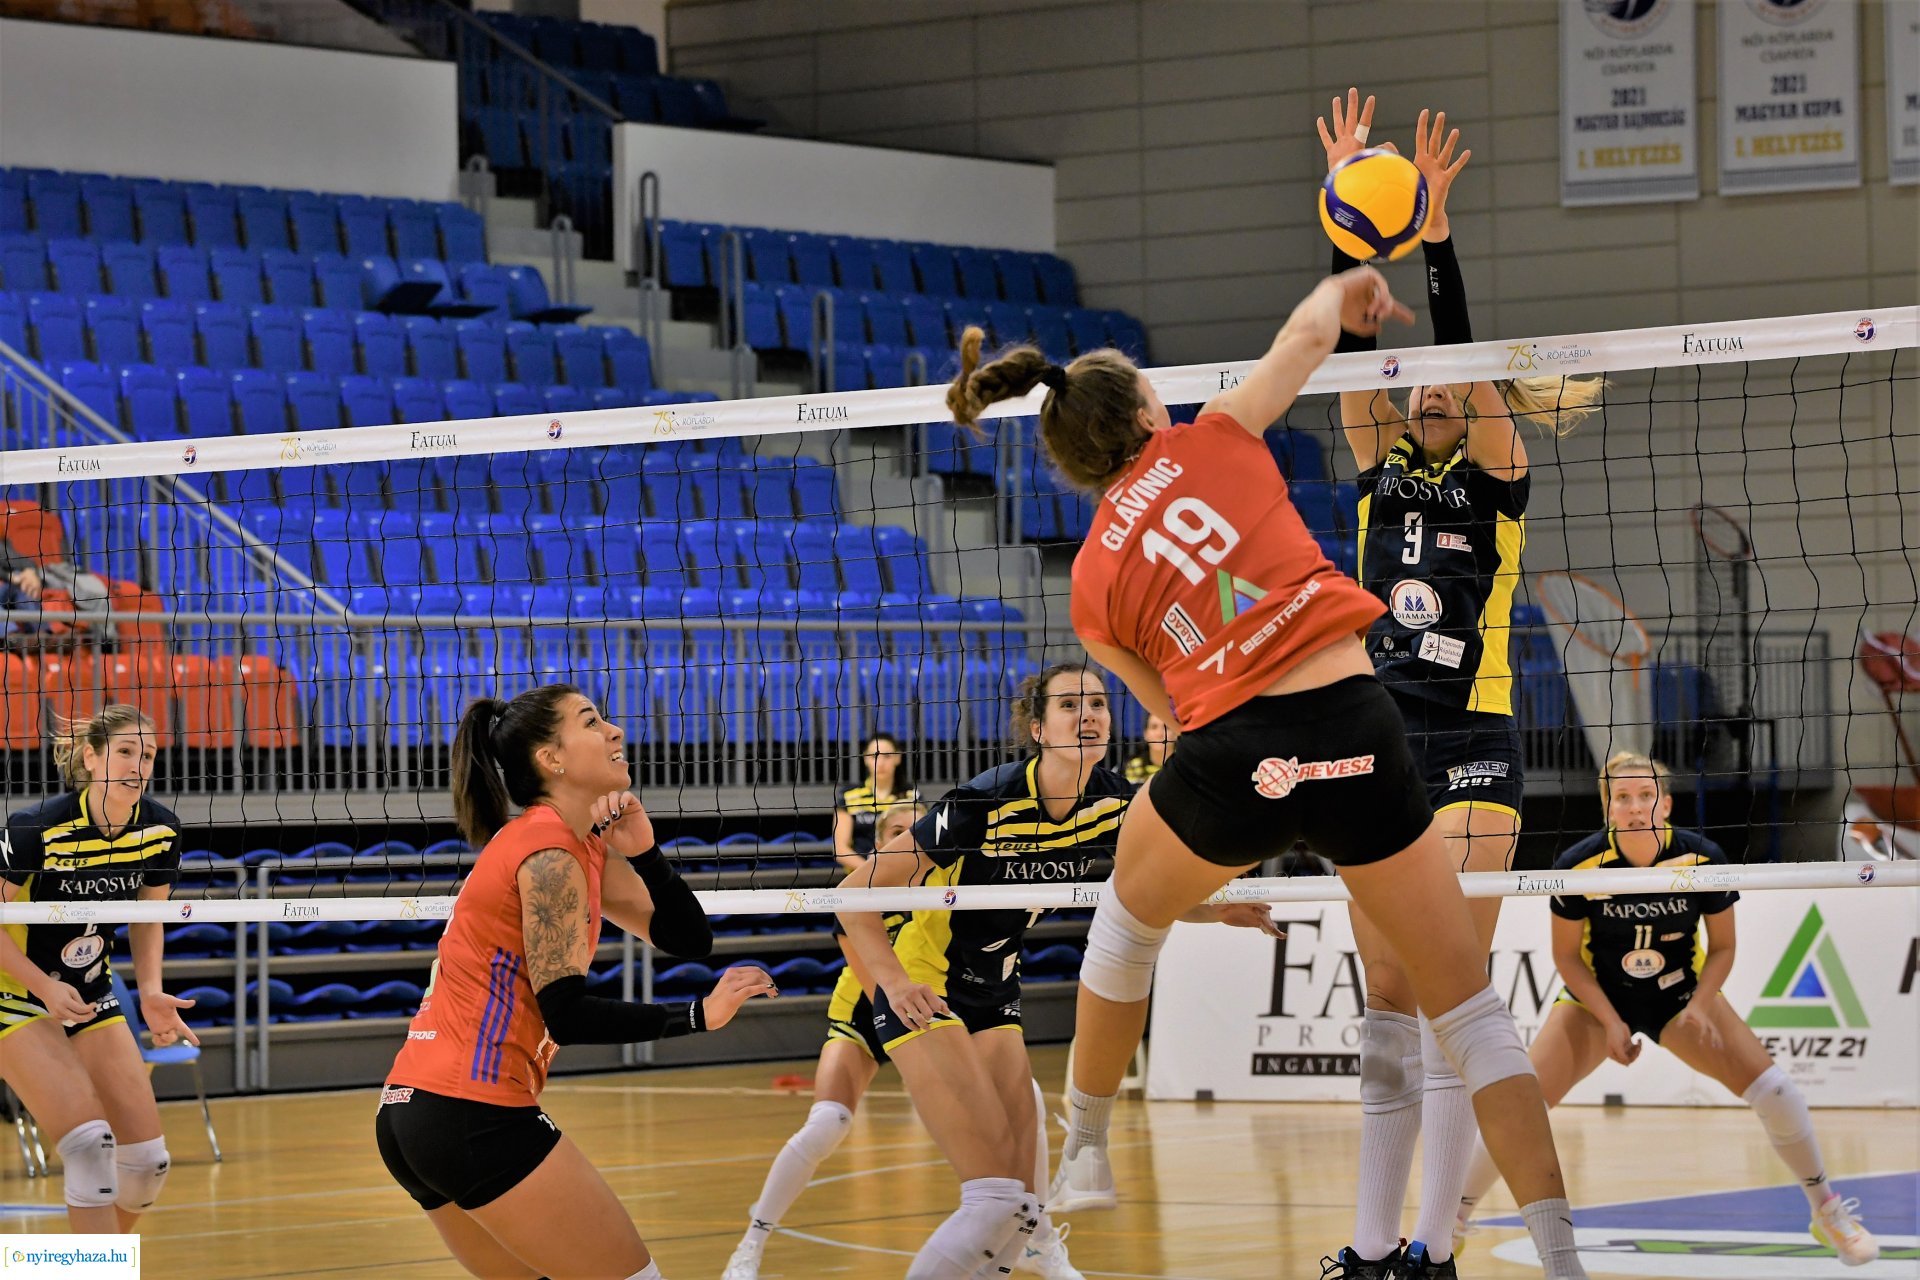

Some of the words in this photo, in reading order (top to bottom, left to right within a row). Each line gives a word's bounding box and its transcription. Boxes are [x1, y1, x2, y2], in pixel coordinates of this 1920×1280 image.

[1681, 332, 1744, 354] FATUM
[796, 403, 848, 422] FATUM
[411, 431, 457, 449] FATUM
[57, 453, 101, 472] FATUM
[1101, 457, 1184, 551] GLAVINIC
[1141, 496, 1241, 586] 19
[1401, 511, 1423, 565] 9
[1239, 579, 1322, 656] BESTRONG
[1395, 612, 1439, 620] DIAMANT
[1167, 612, 1200, 652] RABAG
[1516, 875, 1565, 891] FATUM
[283, 902, 319, 917] FATUM
[1603, 897, 1689, 919] KAPOSVÁR
[1633, 924, 1653, 950] 11
[407, 1030, 437, 1040] STRONG
[1838, 1037, 1867, 1058] 21
